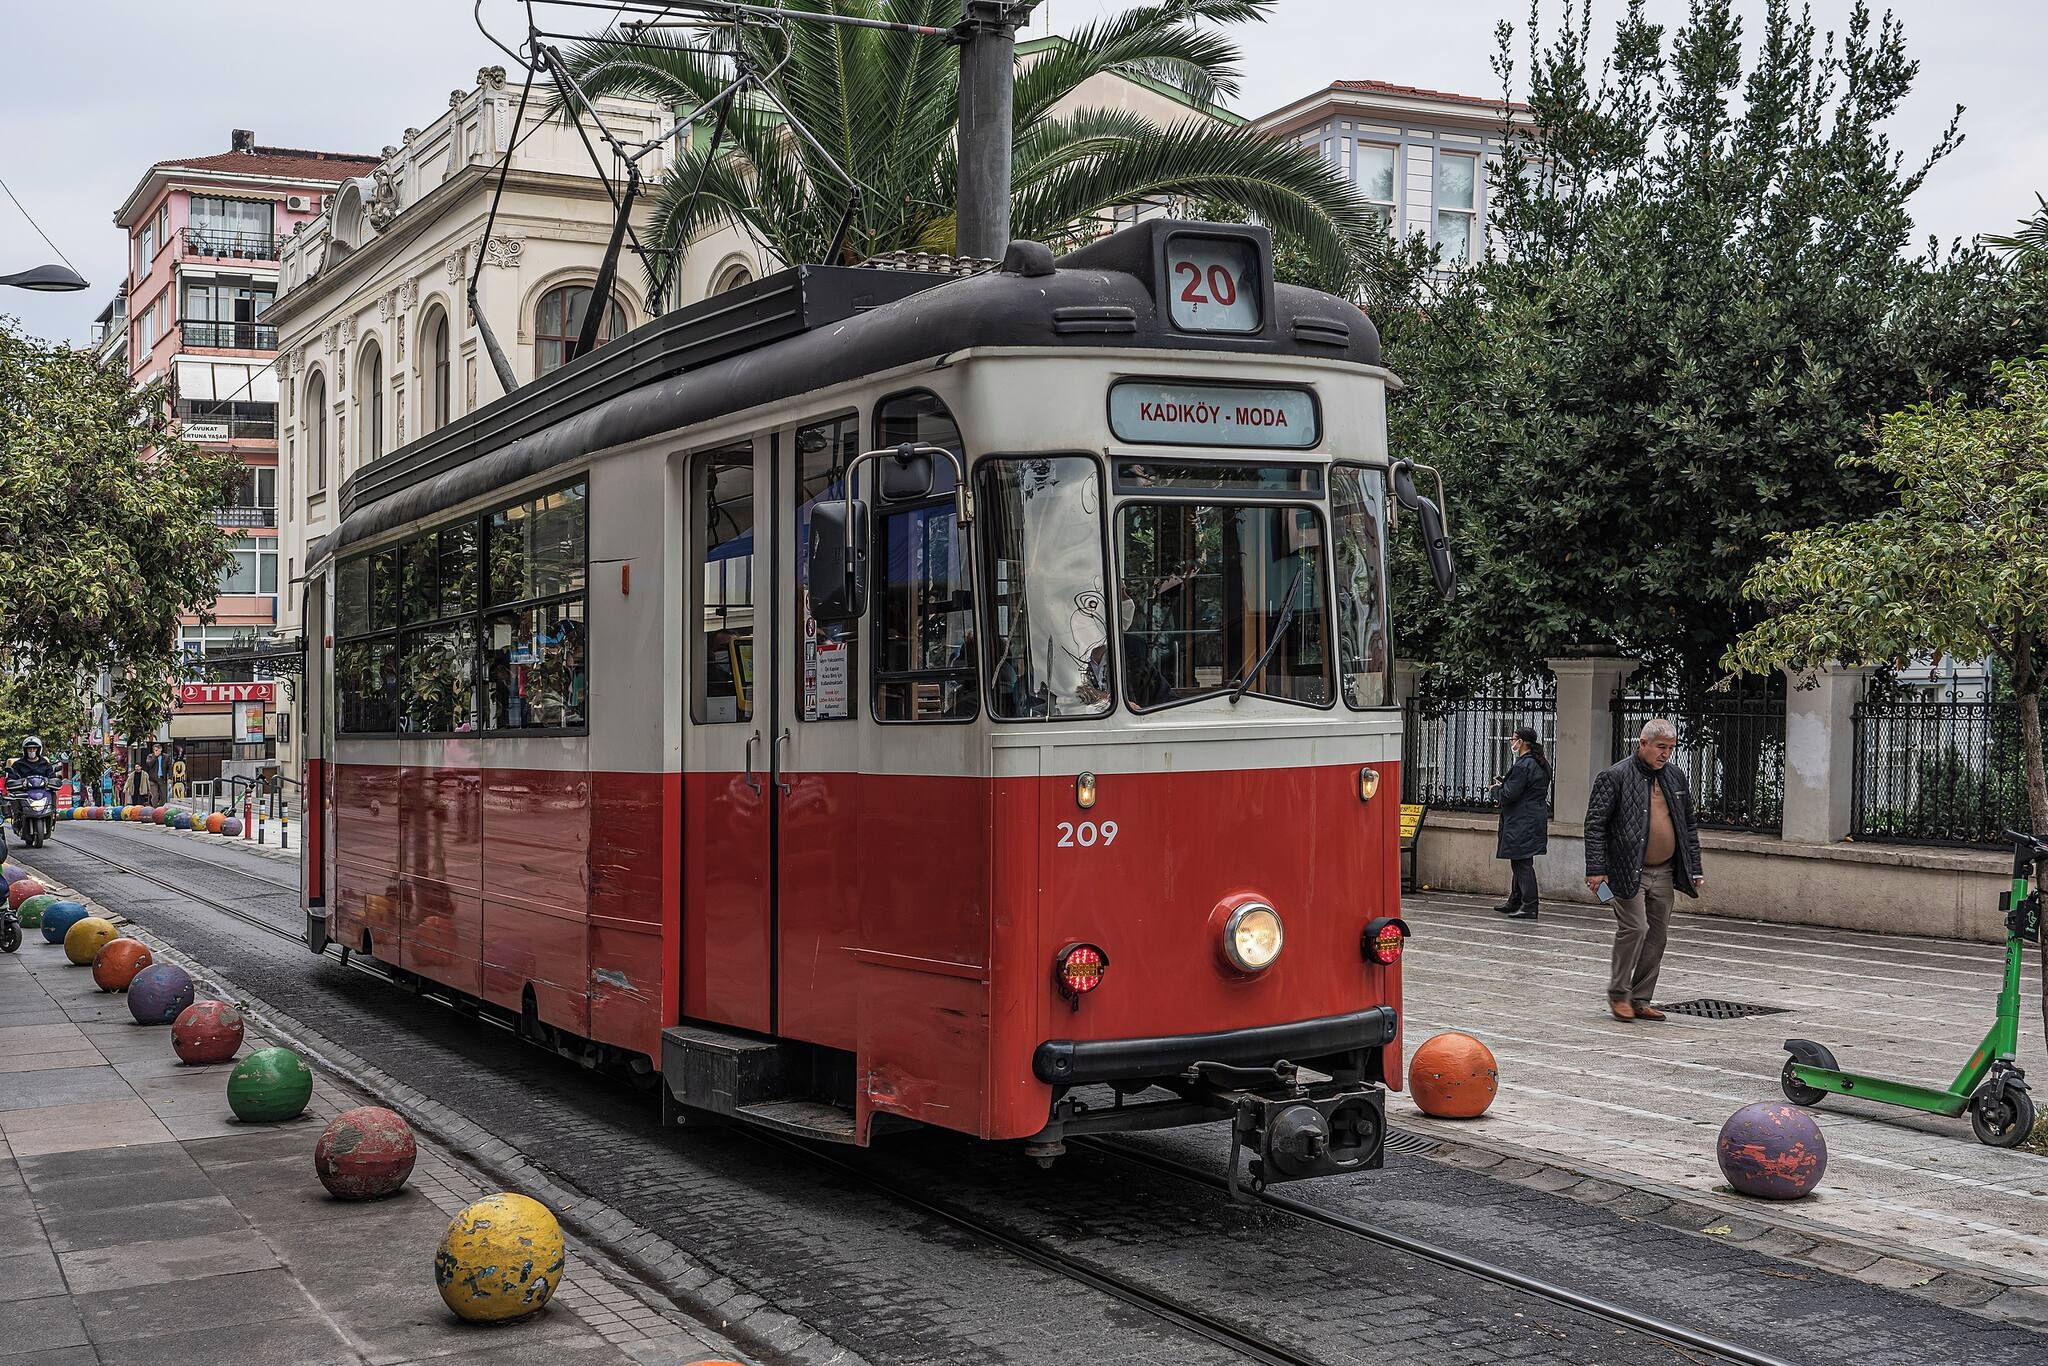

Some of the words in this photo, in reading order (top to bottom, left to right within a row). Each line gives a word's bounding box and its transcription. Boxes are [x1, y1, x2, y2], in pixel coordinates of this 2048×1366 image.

[1174, 261, 1237, 306] 20
[1140, 401, 1221, 424] KADIKÖY
[1235, 406, 1288, 427] MODA
[201, 685, 254, 701] THY
[1056, 820, 1119, 848] 209
[2004, 935, 2016, 989] MARTI
